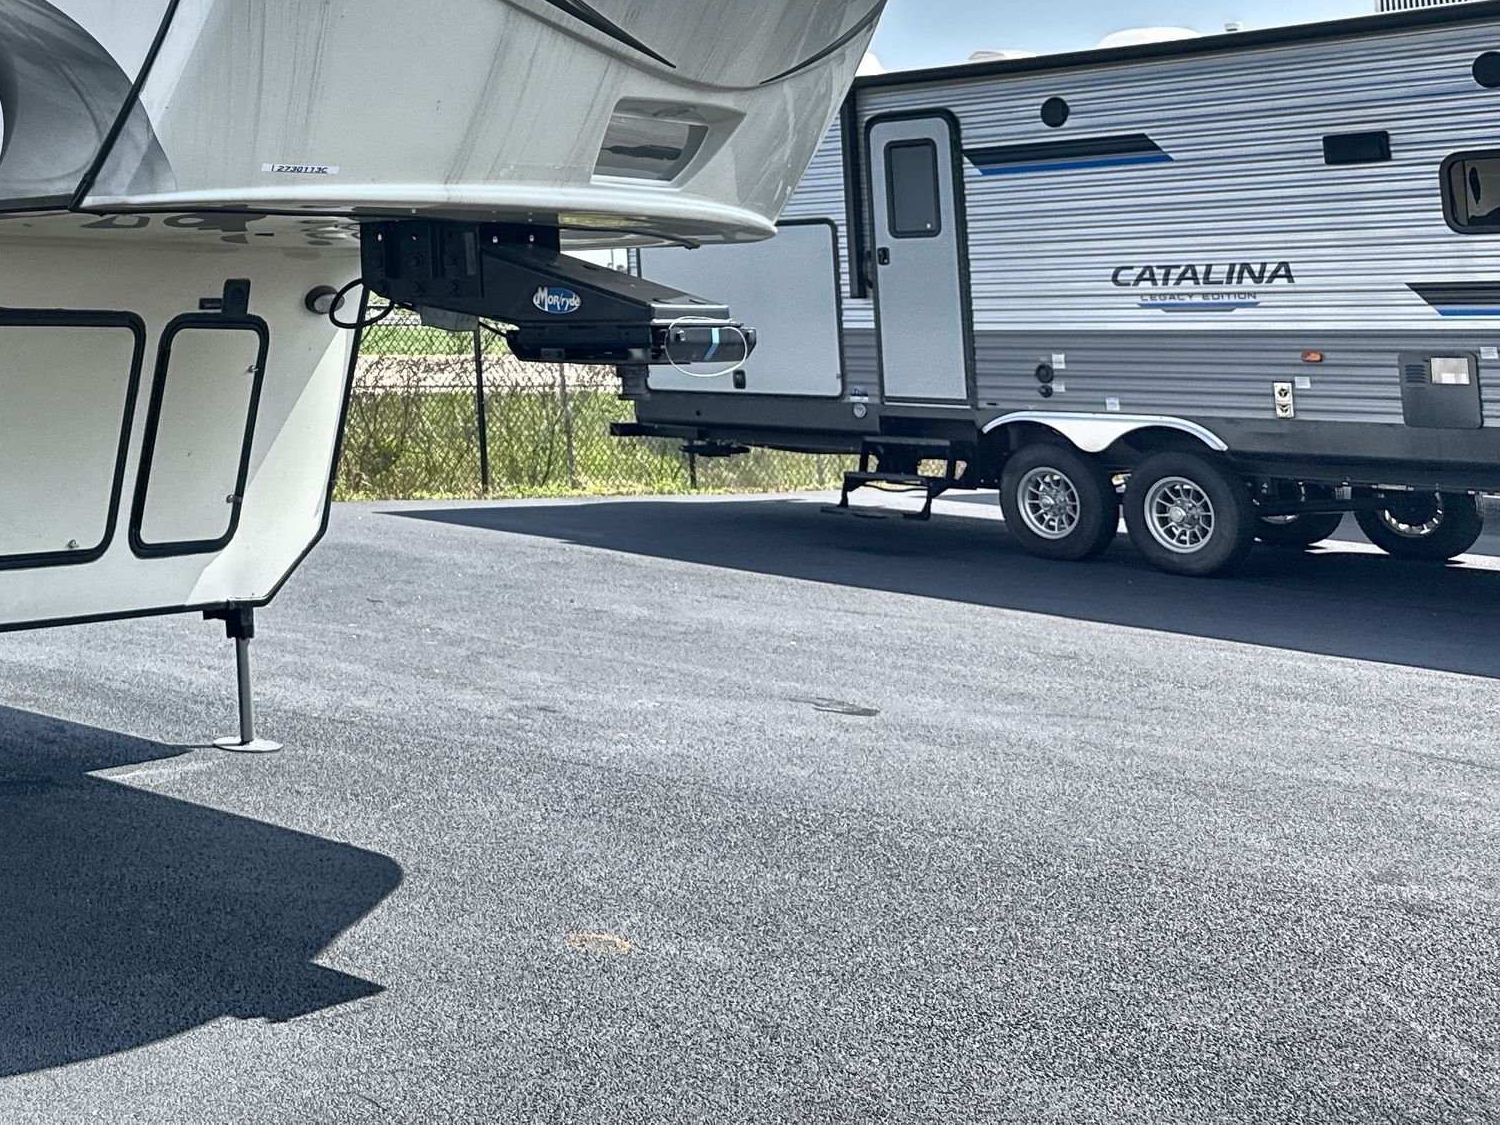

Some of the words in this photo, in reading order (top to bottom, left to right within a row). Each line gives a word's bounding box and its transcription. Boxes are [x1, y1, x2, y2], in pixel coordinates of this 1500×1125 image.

[1111, 261, 1295, 287] CATALINA
[1140, 292, 1195, 302] LEGACY
[1202, 291, 1257, 301] EDITION
